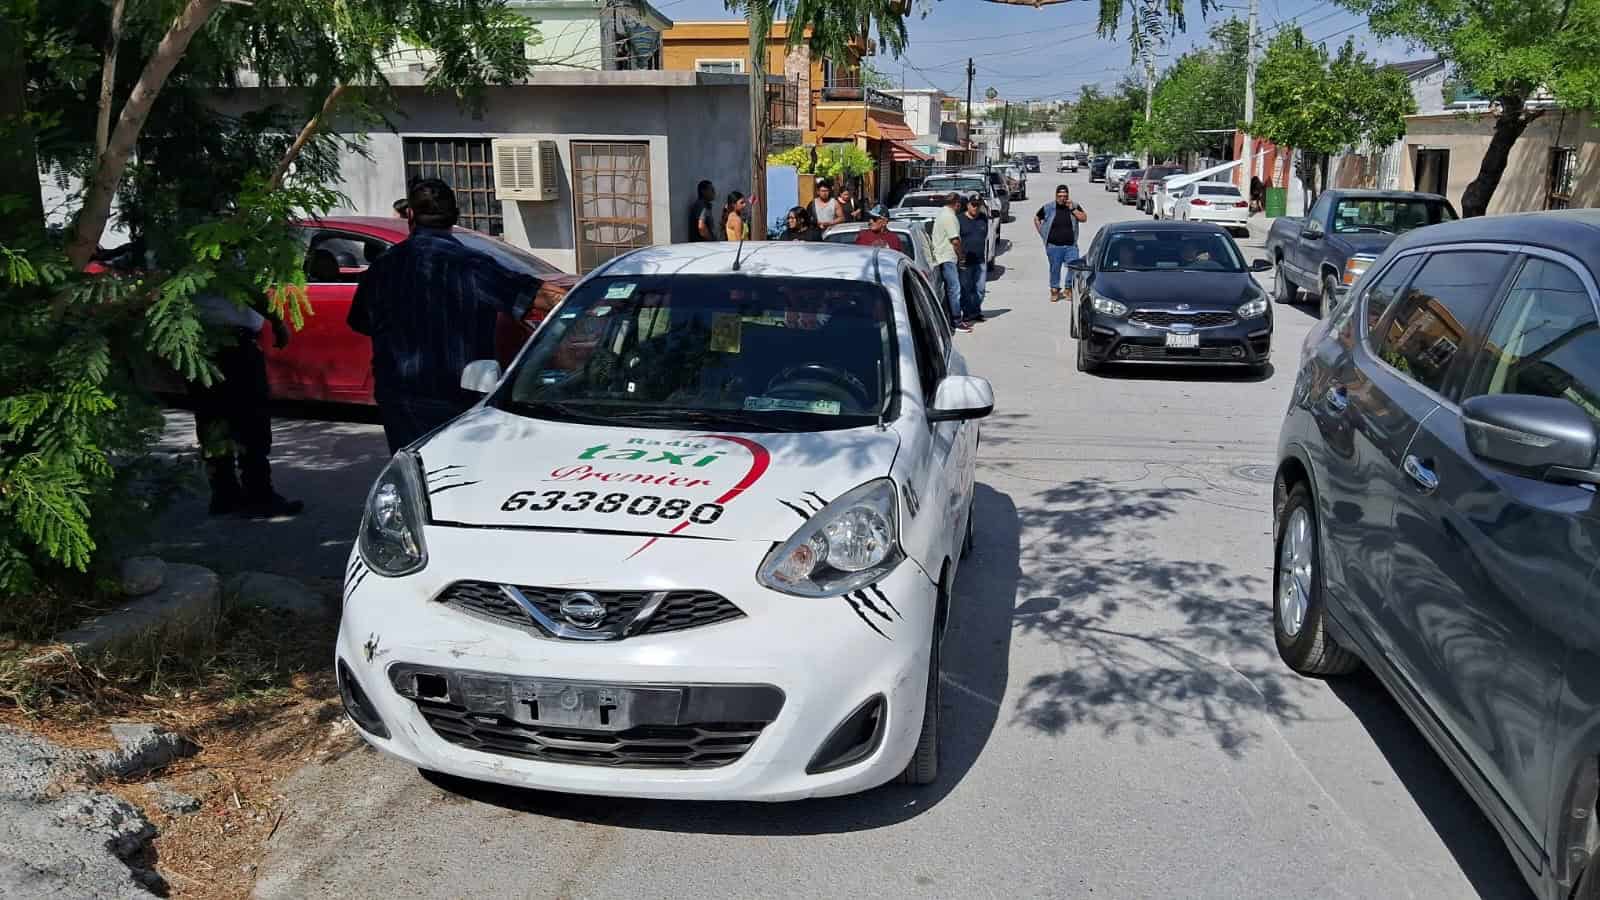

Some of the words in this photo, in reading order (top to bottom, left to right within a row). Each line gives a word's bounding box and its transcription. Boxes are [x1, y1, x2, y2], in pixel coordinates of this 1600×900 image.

[627, 437, 709, 449] Radio
[577, 444, 728, 467] taxi
[541, 464, 713, 488] Premier
[500, 490, 725, 524] 6338080
